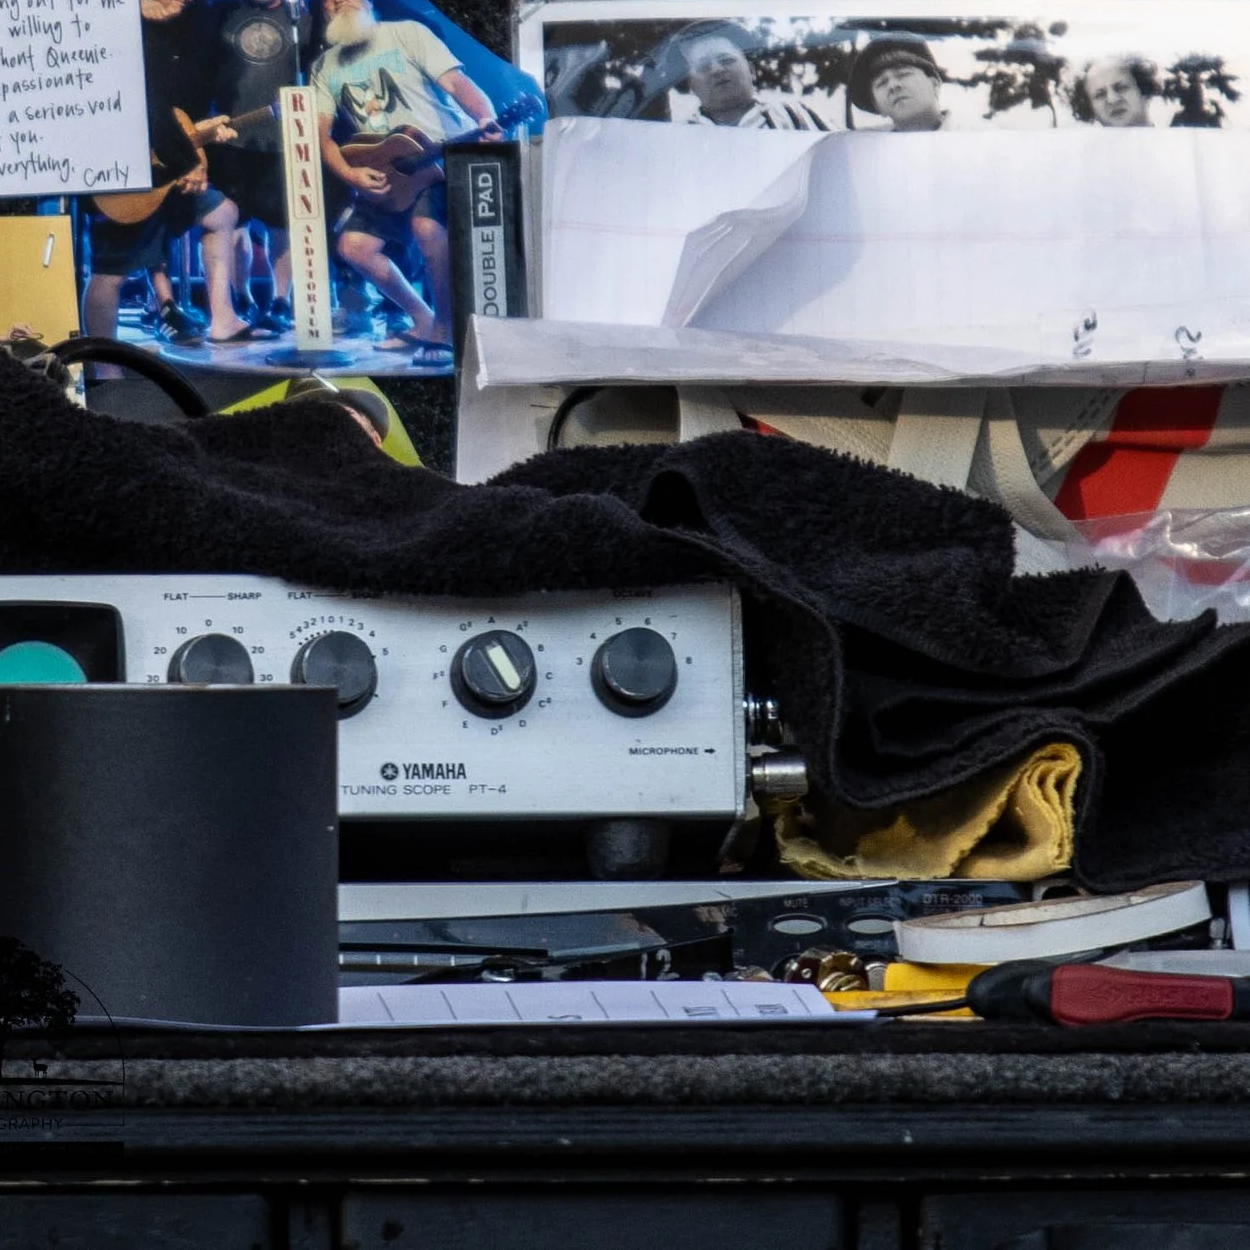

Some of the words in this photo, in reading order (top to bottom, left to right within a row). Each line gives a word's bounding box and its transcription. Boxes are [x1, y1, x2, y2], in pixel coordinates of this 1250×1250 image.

[26, 103, 84, 121] serious
[87, 90, 122, 114] void
[290, 92, 314, 216] RYMAN
[84, 161, 129, 187] Carly
[478, 172, 495, 218] PAD
[481, 230, 499, 315] DOUBLE
[304, 224, 320, 341] AUDITORIUM
[164, 593, 188, 601] FLAT
[227, 592, 262, 600] SHARP
[288, 591, 312, 600] FLAT
[176, 626, 187, 635] 10
[232, 626, 244, 635] 10
[154, 646, 167, 655] 20
[251, 646, 265, 654] 20
[260, 673, 273, 682] 30
[629, 747, 699, 756] MICROPHONE
[402, 763, 467, 780] YAMAHA
[341, 784, 397, 795] TUNING
[403, 784, 452, 795] SCOPE
[468, 784, 507, 794] PT-4
